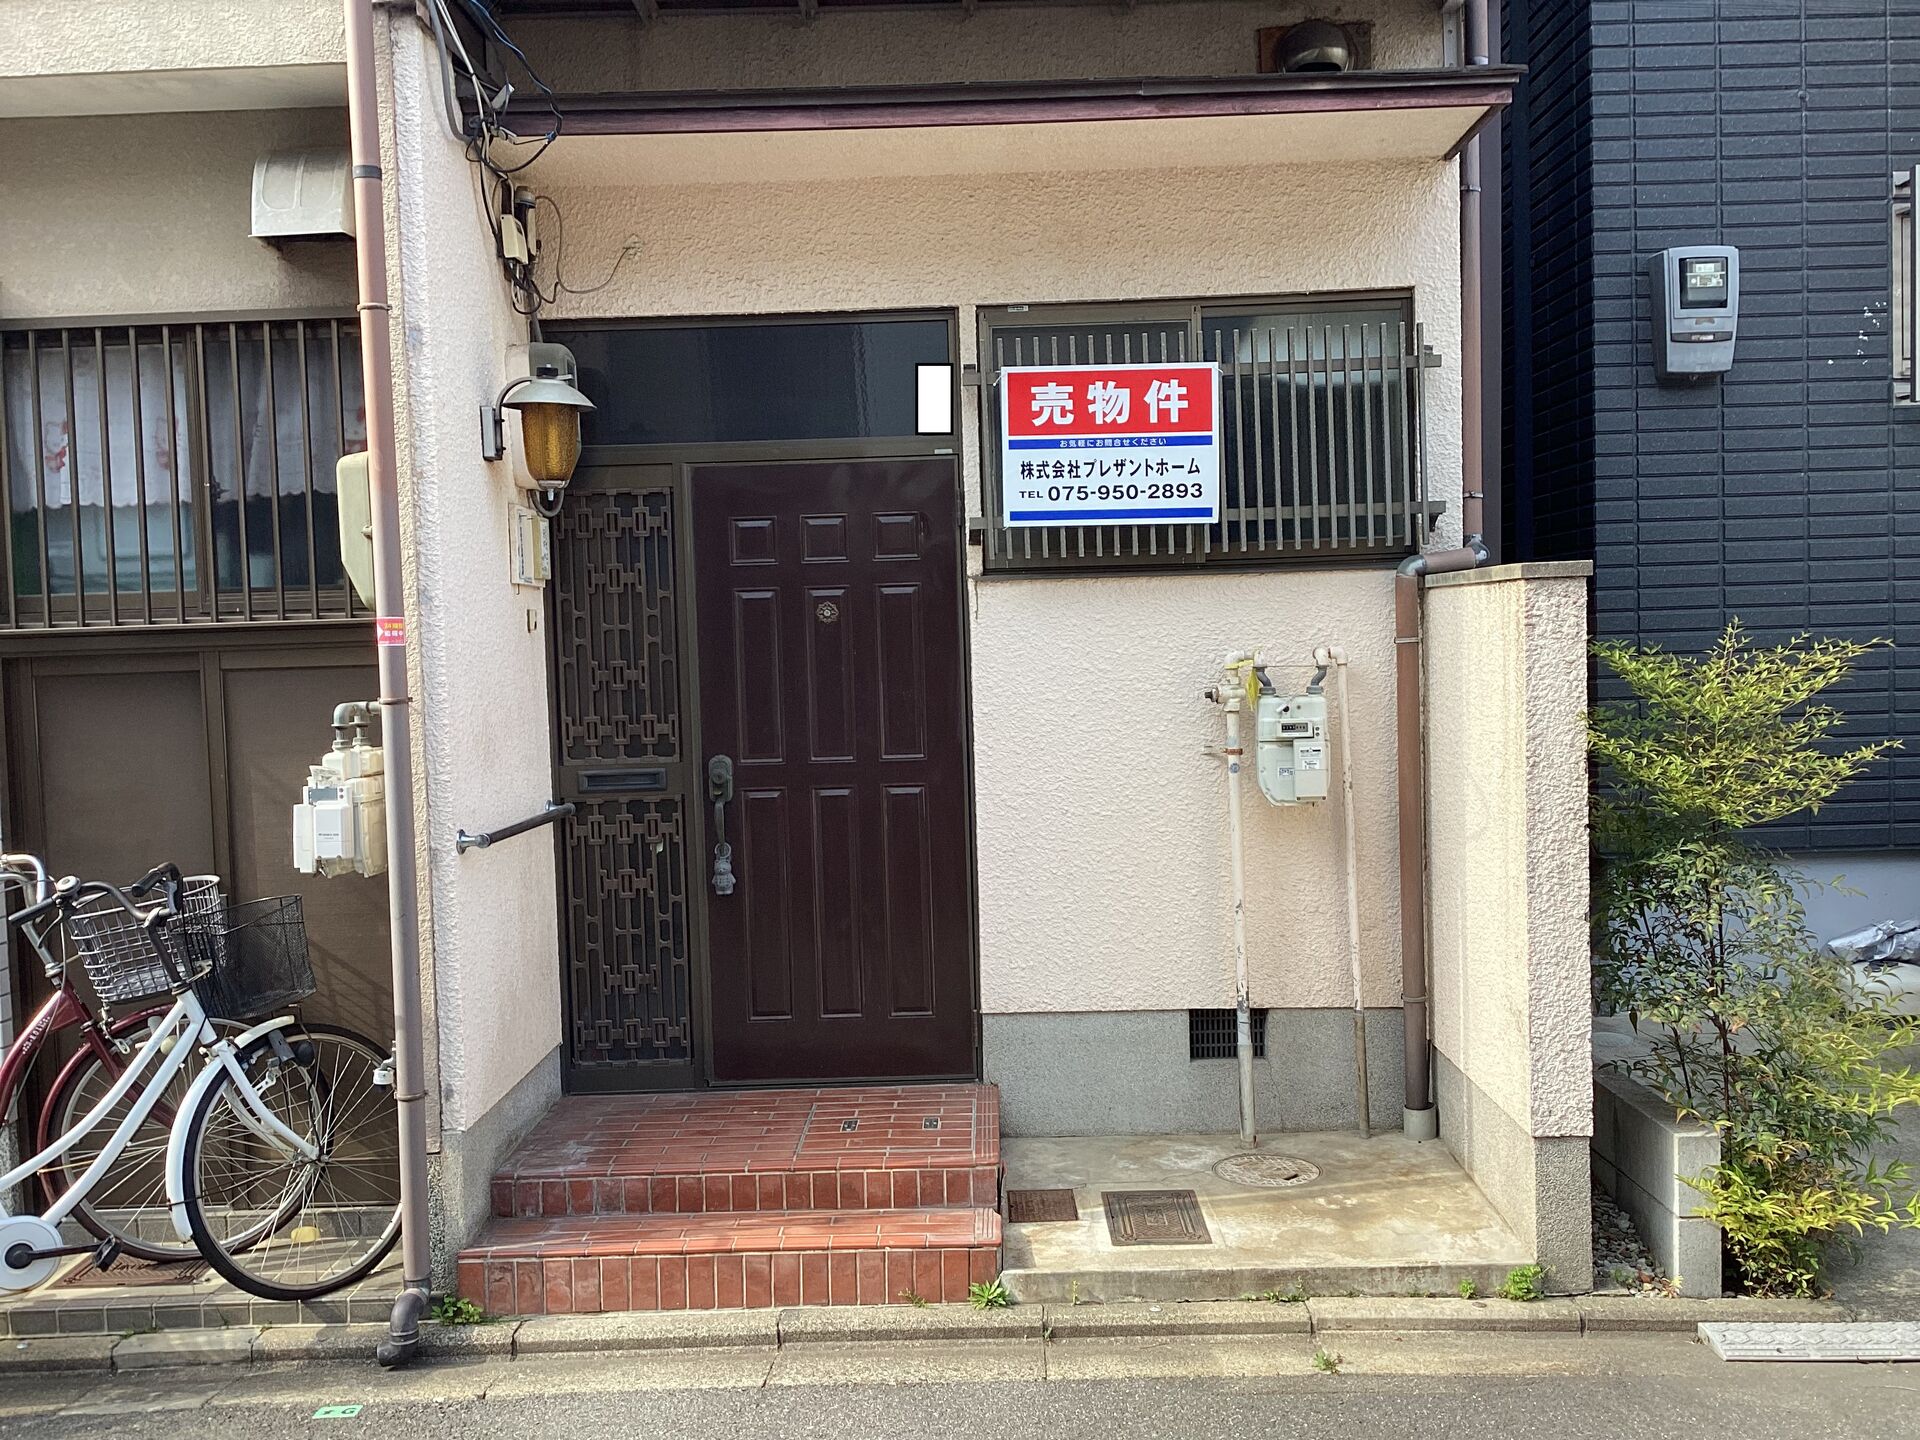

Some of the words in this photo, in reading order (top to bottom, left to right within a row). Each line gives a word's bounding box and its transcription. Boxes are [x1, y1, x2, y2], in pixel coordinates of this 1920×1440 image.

[1030, 379, 1189, 426] 売物件
[1059, 438, 1167, 448] お気軽にお問合せください
[1020, 457, 1201, 480] 株式会社プレザントホーム
[1019, 491, 1043, 499] TEL
[1048, 483, 1203, 501] 075-950-2893
